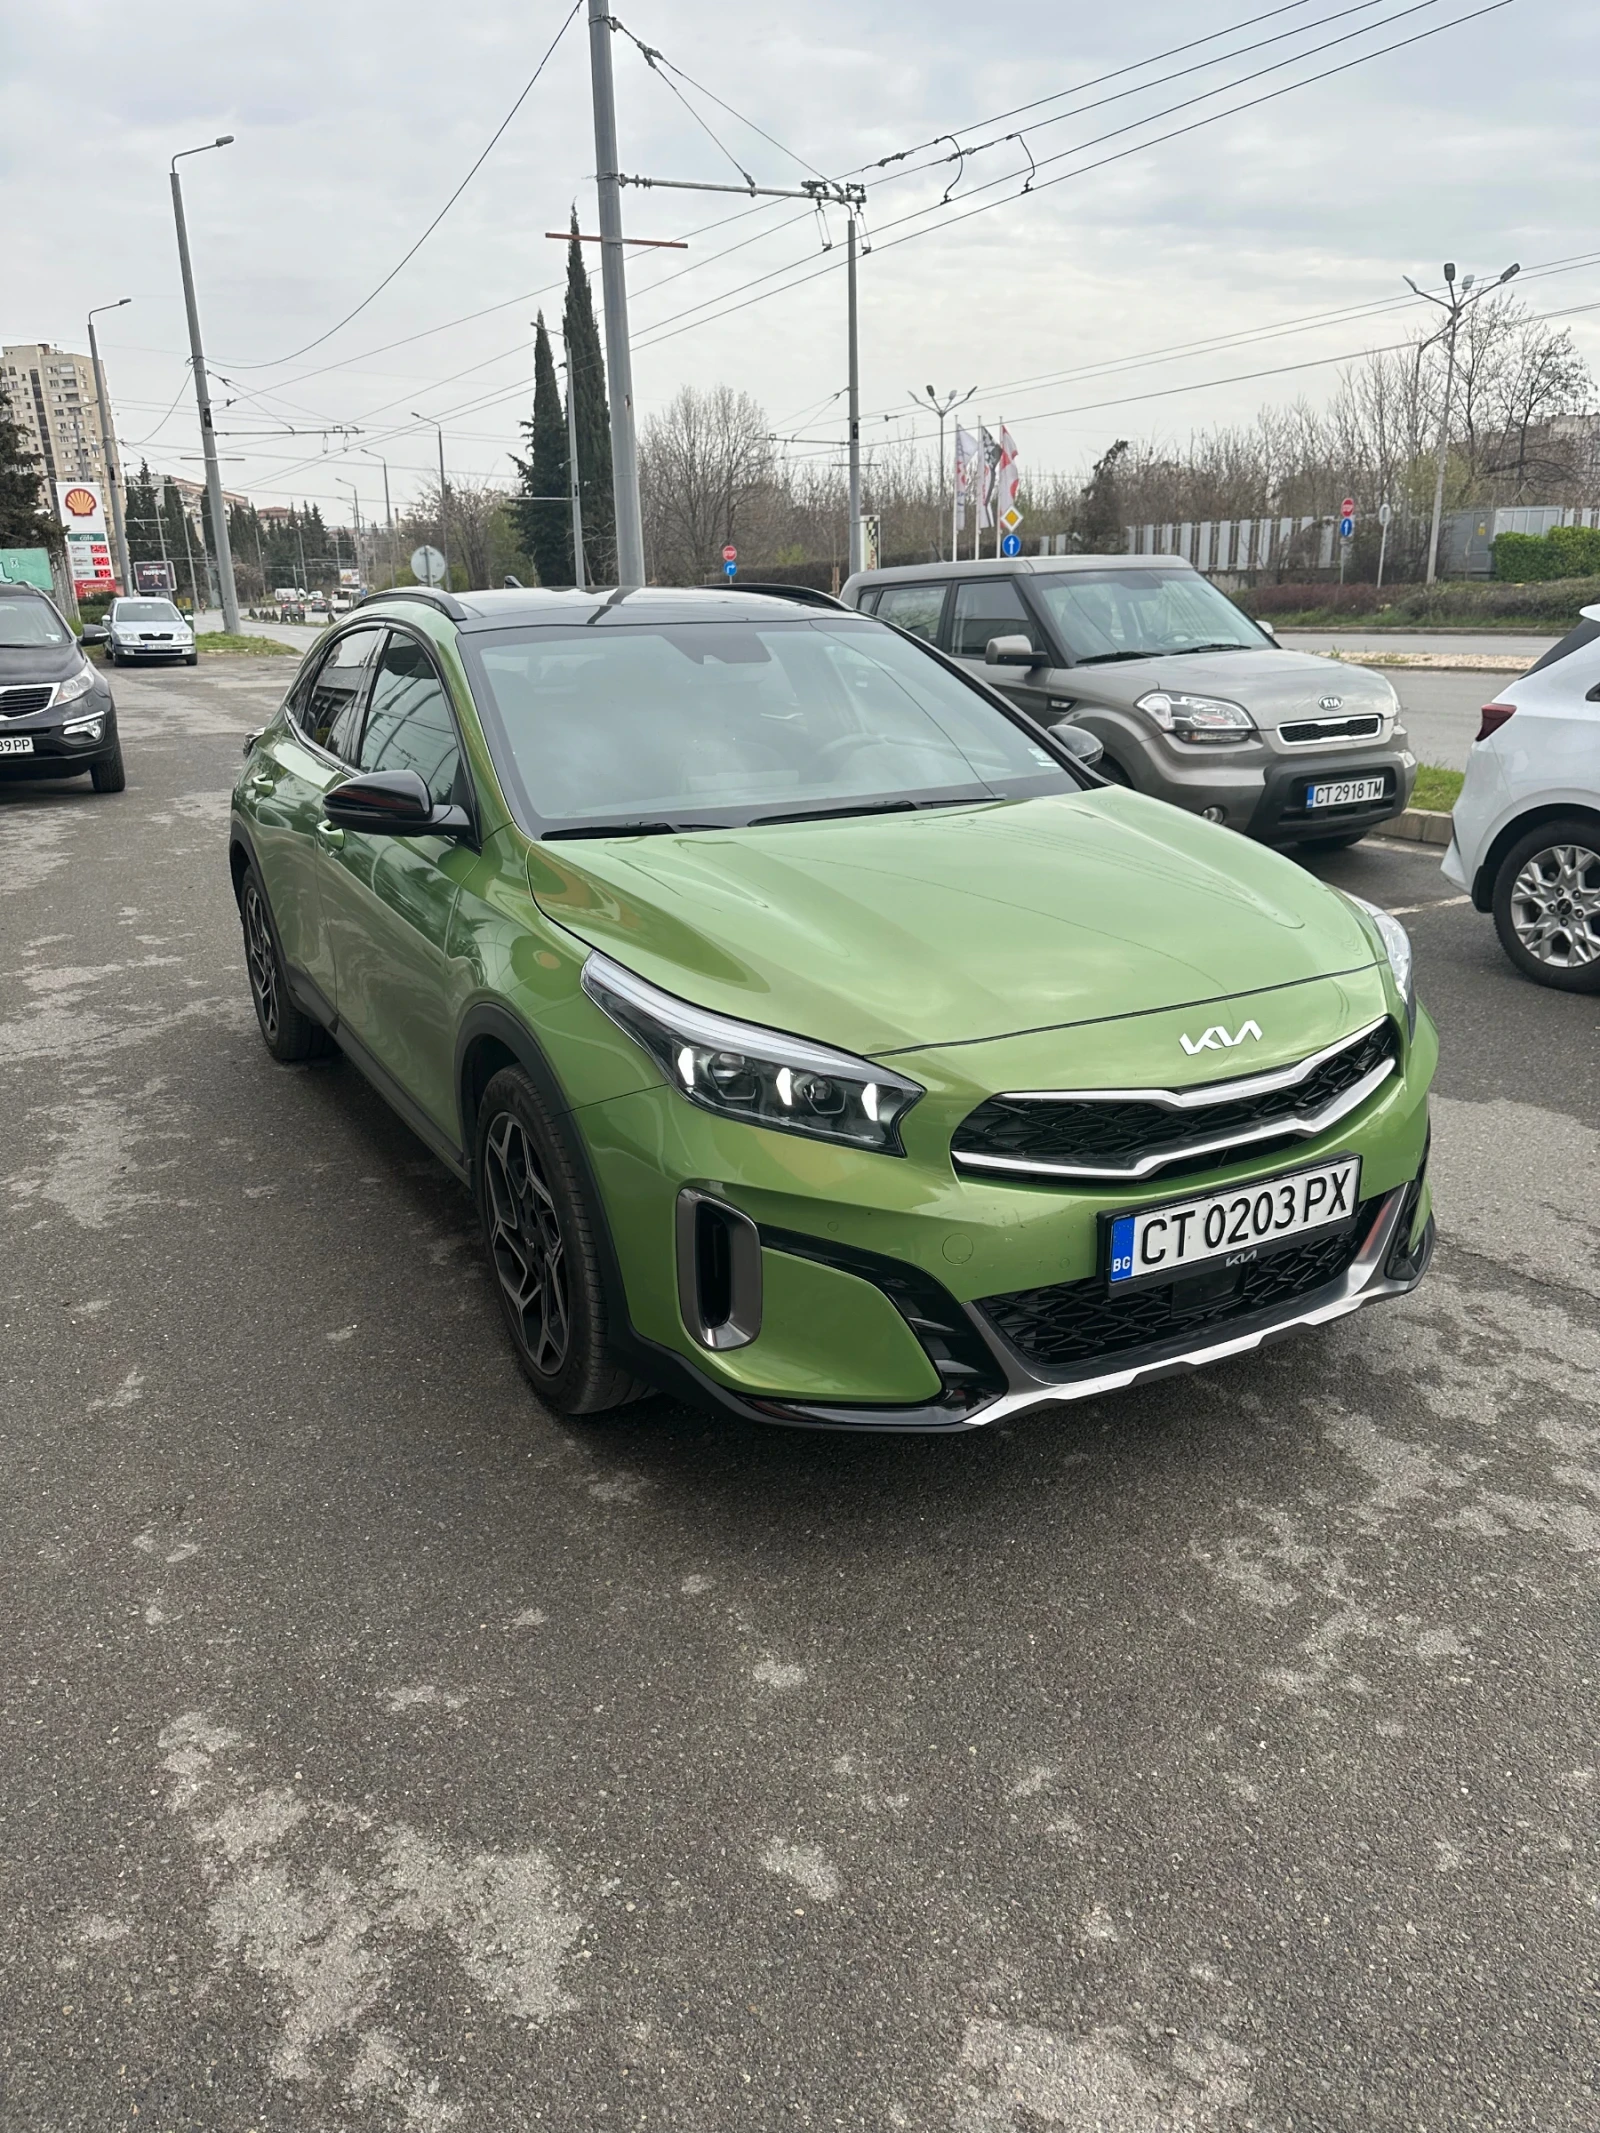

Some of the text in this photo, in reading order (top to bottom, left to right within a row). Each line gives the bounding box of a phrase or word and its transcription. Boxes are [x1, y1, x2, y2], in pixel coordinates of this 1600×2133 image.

[1323, 698, 1340, 708] KIA
[13, 739, 30, 750] PP
[1316, 780, 1382, 804] CT 2918 TM
[1178, 1019, 1263, 1056] KIA
[1141, 1167, 1352, 1266] CT 0203 PX
[1112, 1256, 1131, 1273] BG
[1225, 1250, 1258, 1268] KIA
